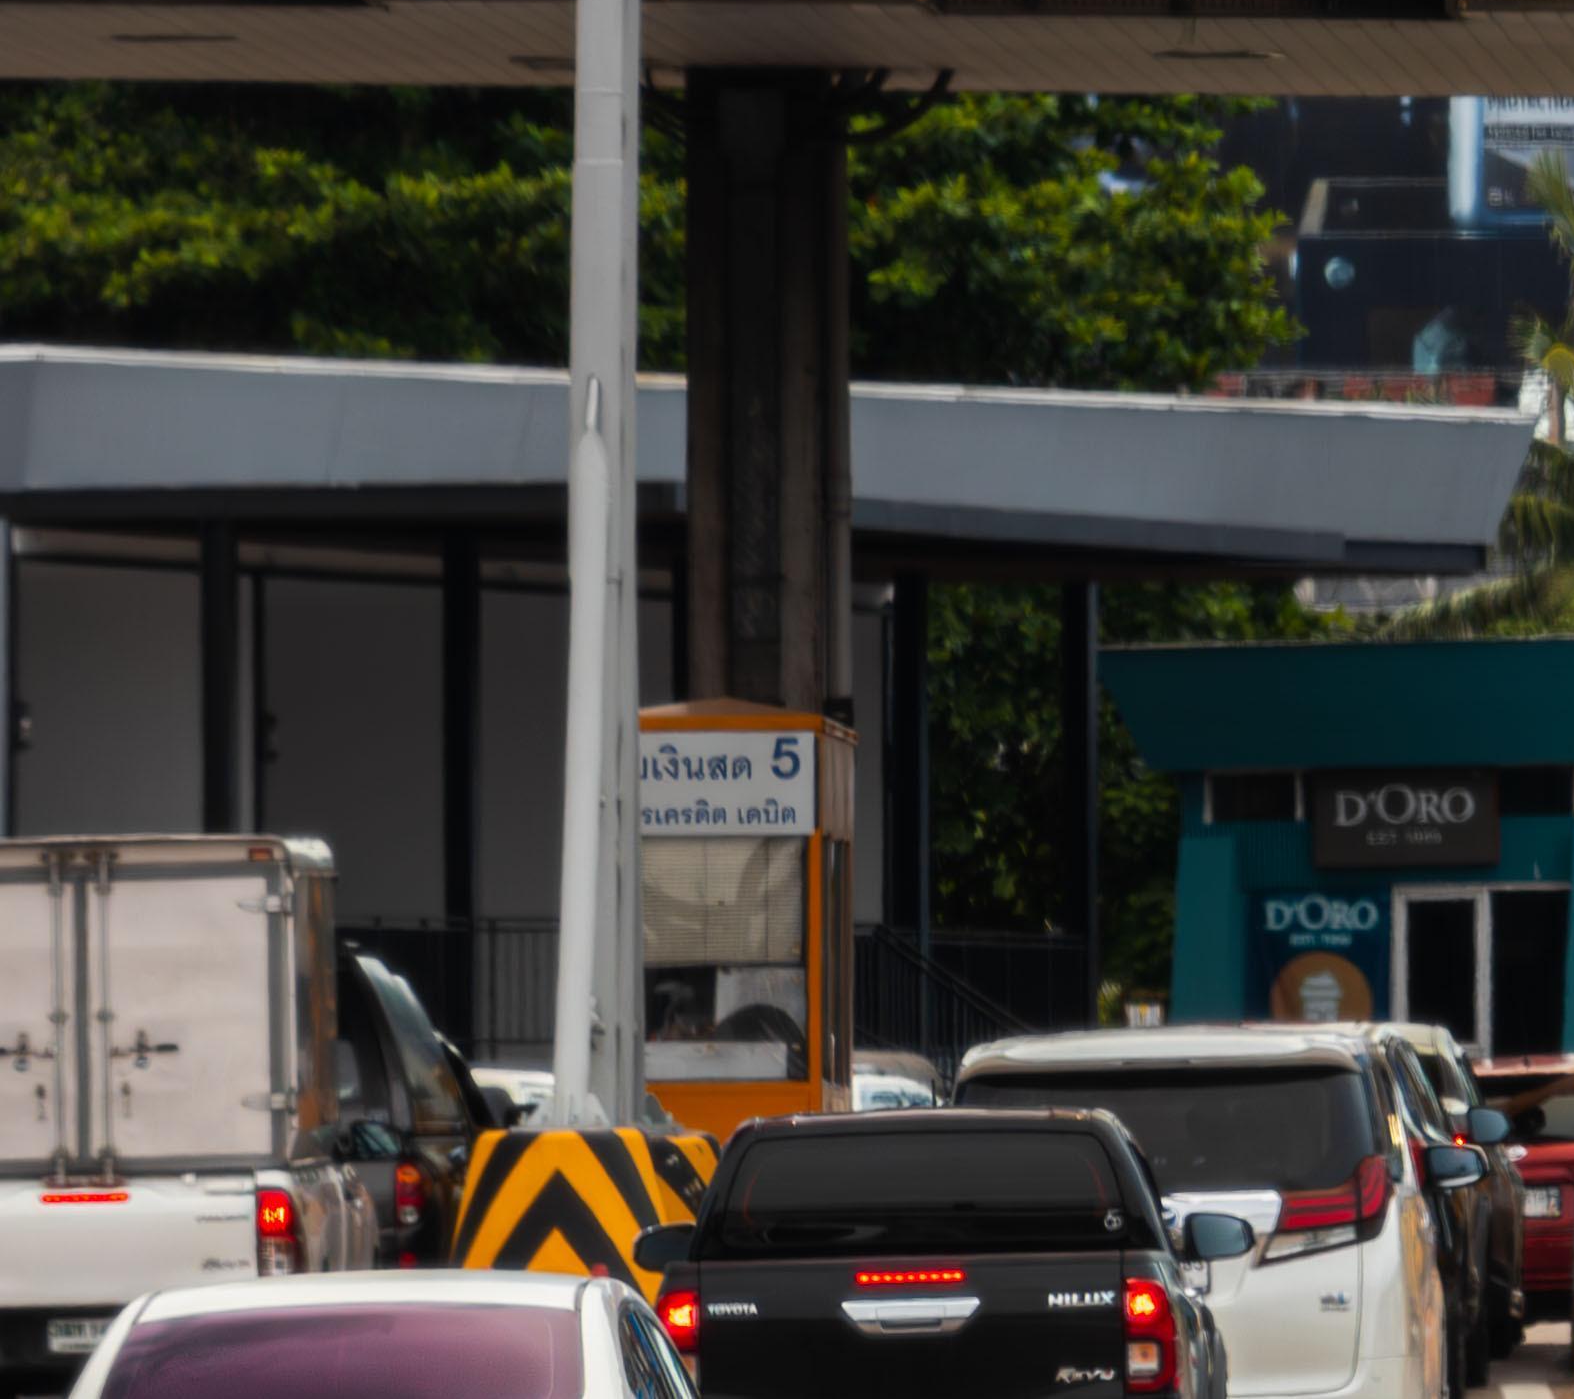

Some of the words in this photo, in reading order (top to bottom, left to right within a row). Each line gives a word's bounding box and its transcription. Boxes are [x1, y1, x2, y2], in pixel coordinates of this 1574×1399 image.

[772, 737, 800, 779] 5
[641, 798, 726, 826] รเครดิต
[738, 798, 796, 825] เดบิต
[1265, 894, 1379, 930] D'ORO
[707, 1303, 758, 1315] TOYOTA
[1048, 1291, 1116, 1306] HILUX
